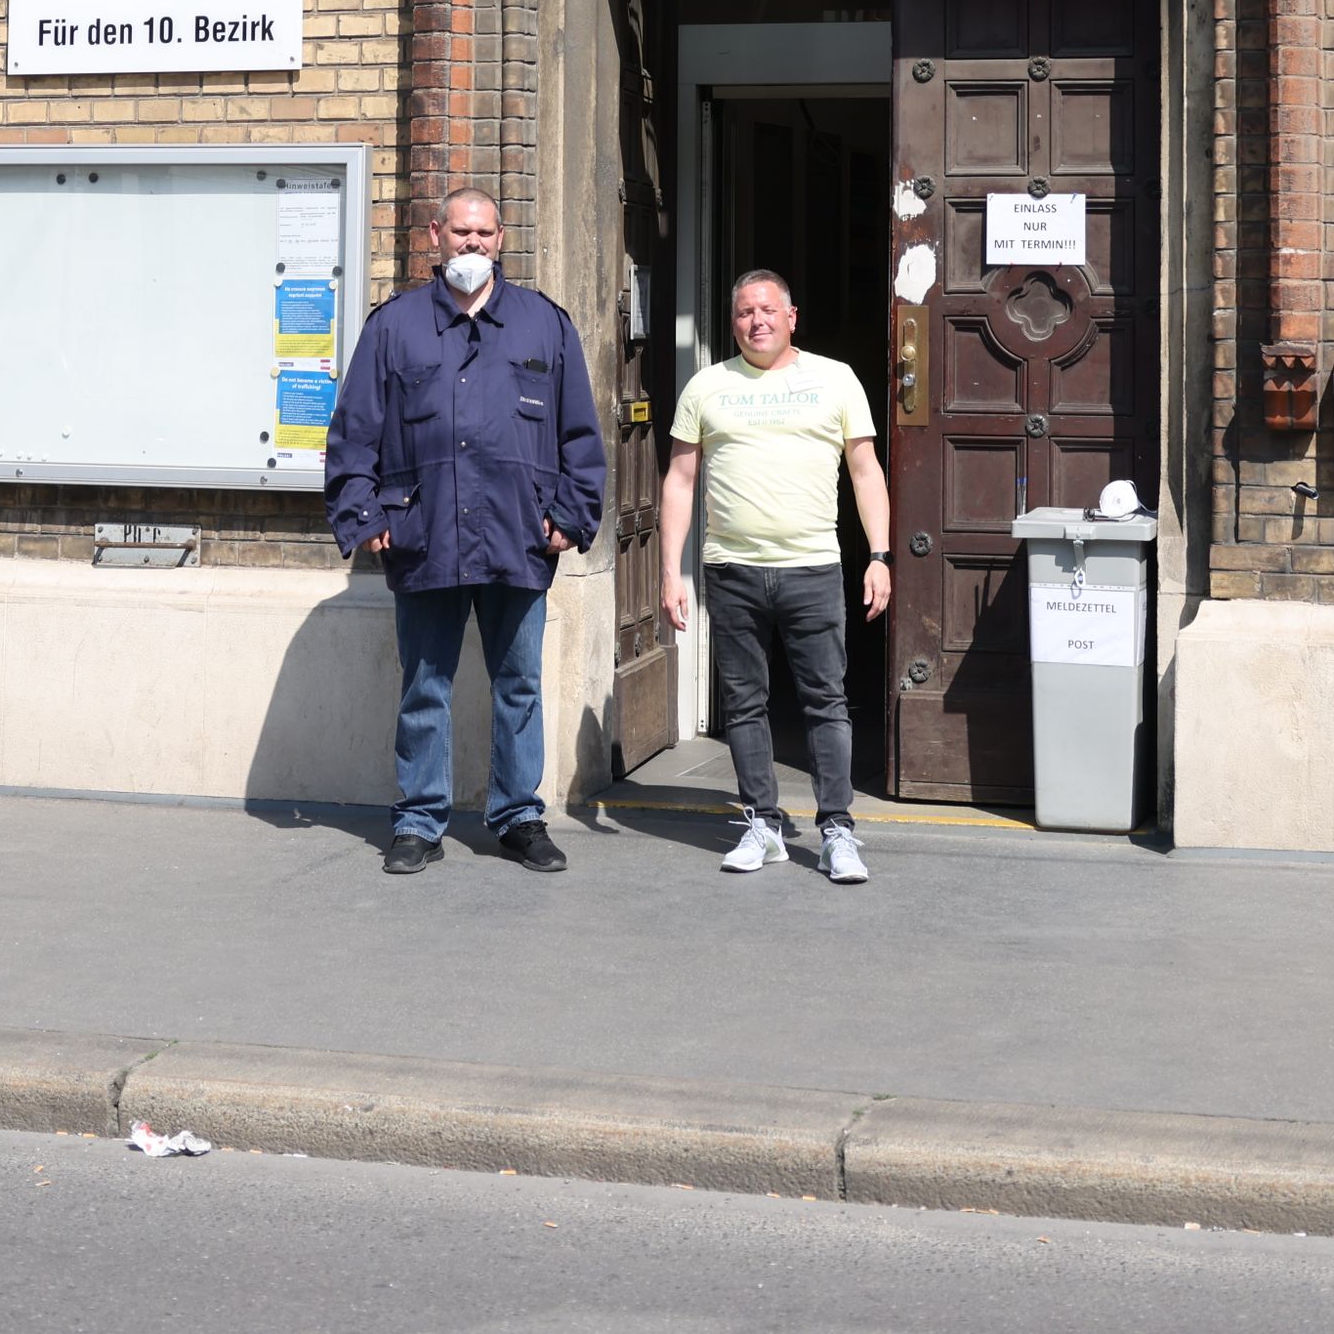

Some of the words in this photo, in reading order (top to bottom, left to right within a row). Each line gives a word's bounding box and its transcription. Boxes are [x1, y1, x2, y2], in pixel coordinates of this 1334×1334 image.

[38, 18, 79, 47] Für
[87, 17, 133, 45] den
[143, 16, 183, 45] 10.
[194, 13, 275, 43] Bezirk
[284, 180, 332, 190] inweistafe
[1014, 203, 1057, 214] EINLASS
[1023, 221, 1047, 231] NUR
[994, 239, 1016, 249] MIT
[1021, 239, 1077, 250] TERMIN!!!
[719, 394, 755, 406] TOM
[760, 393, 819, 405] TAILOR
[1046, 601, 1117, 614] MELDEZETTEL
[1067, 639, 1095, 651] POST
